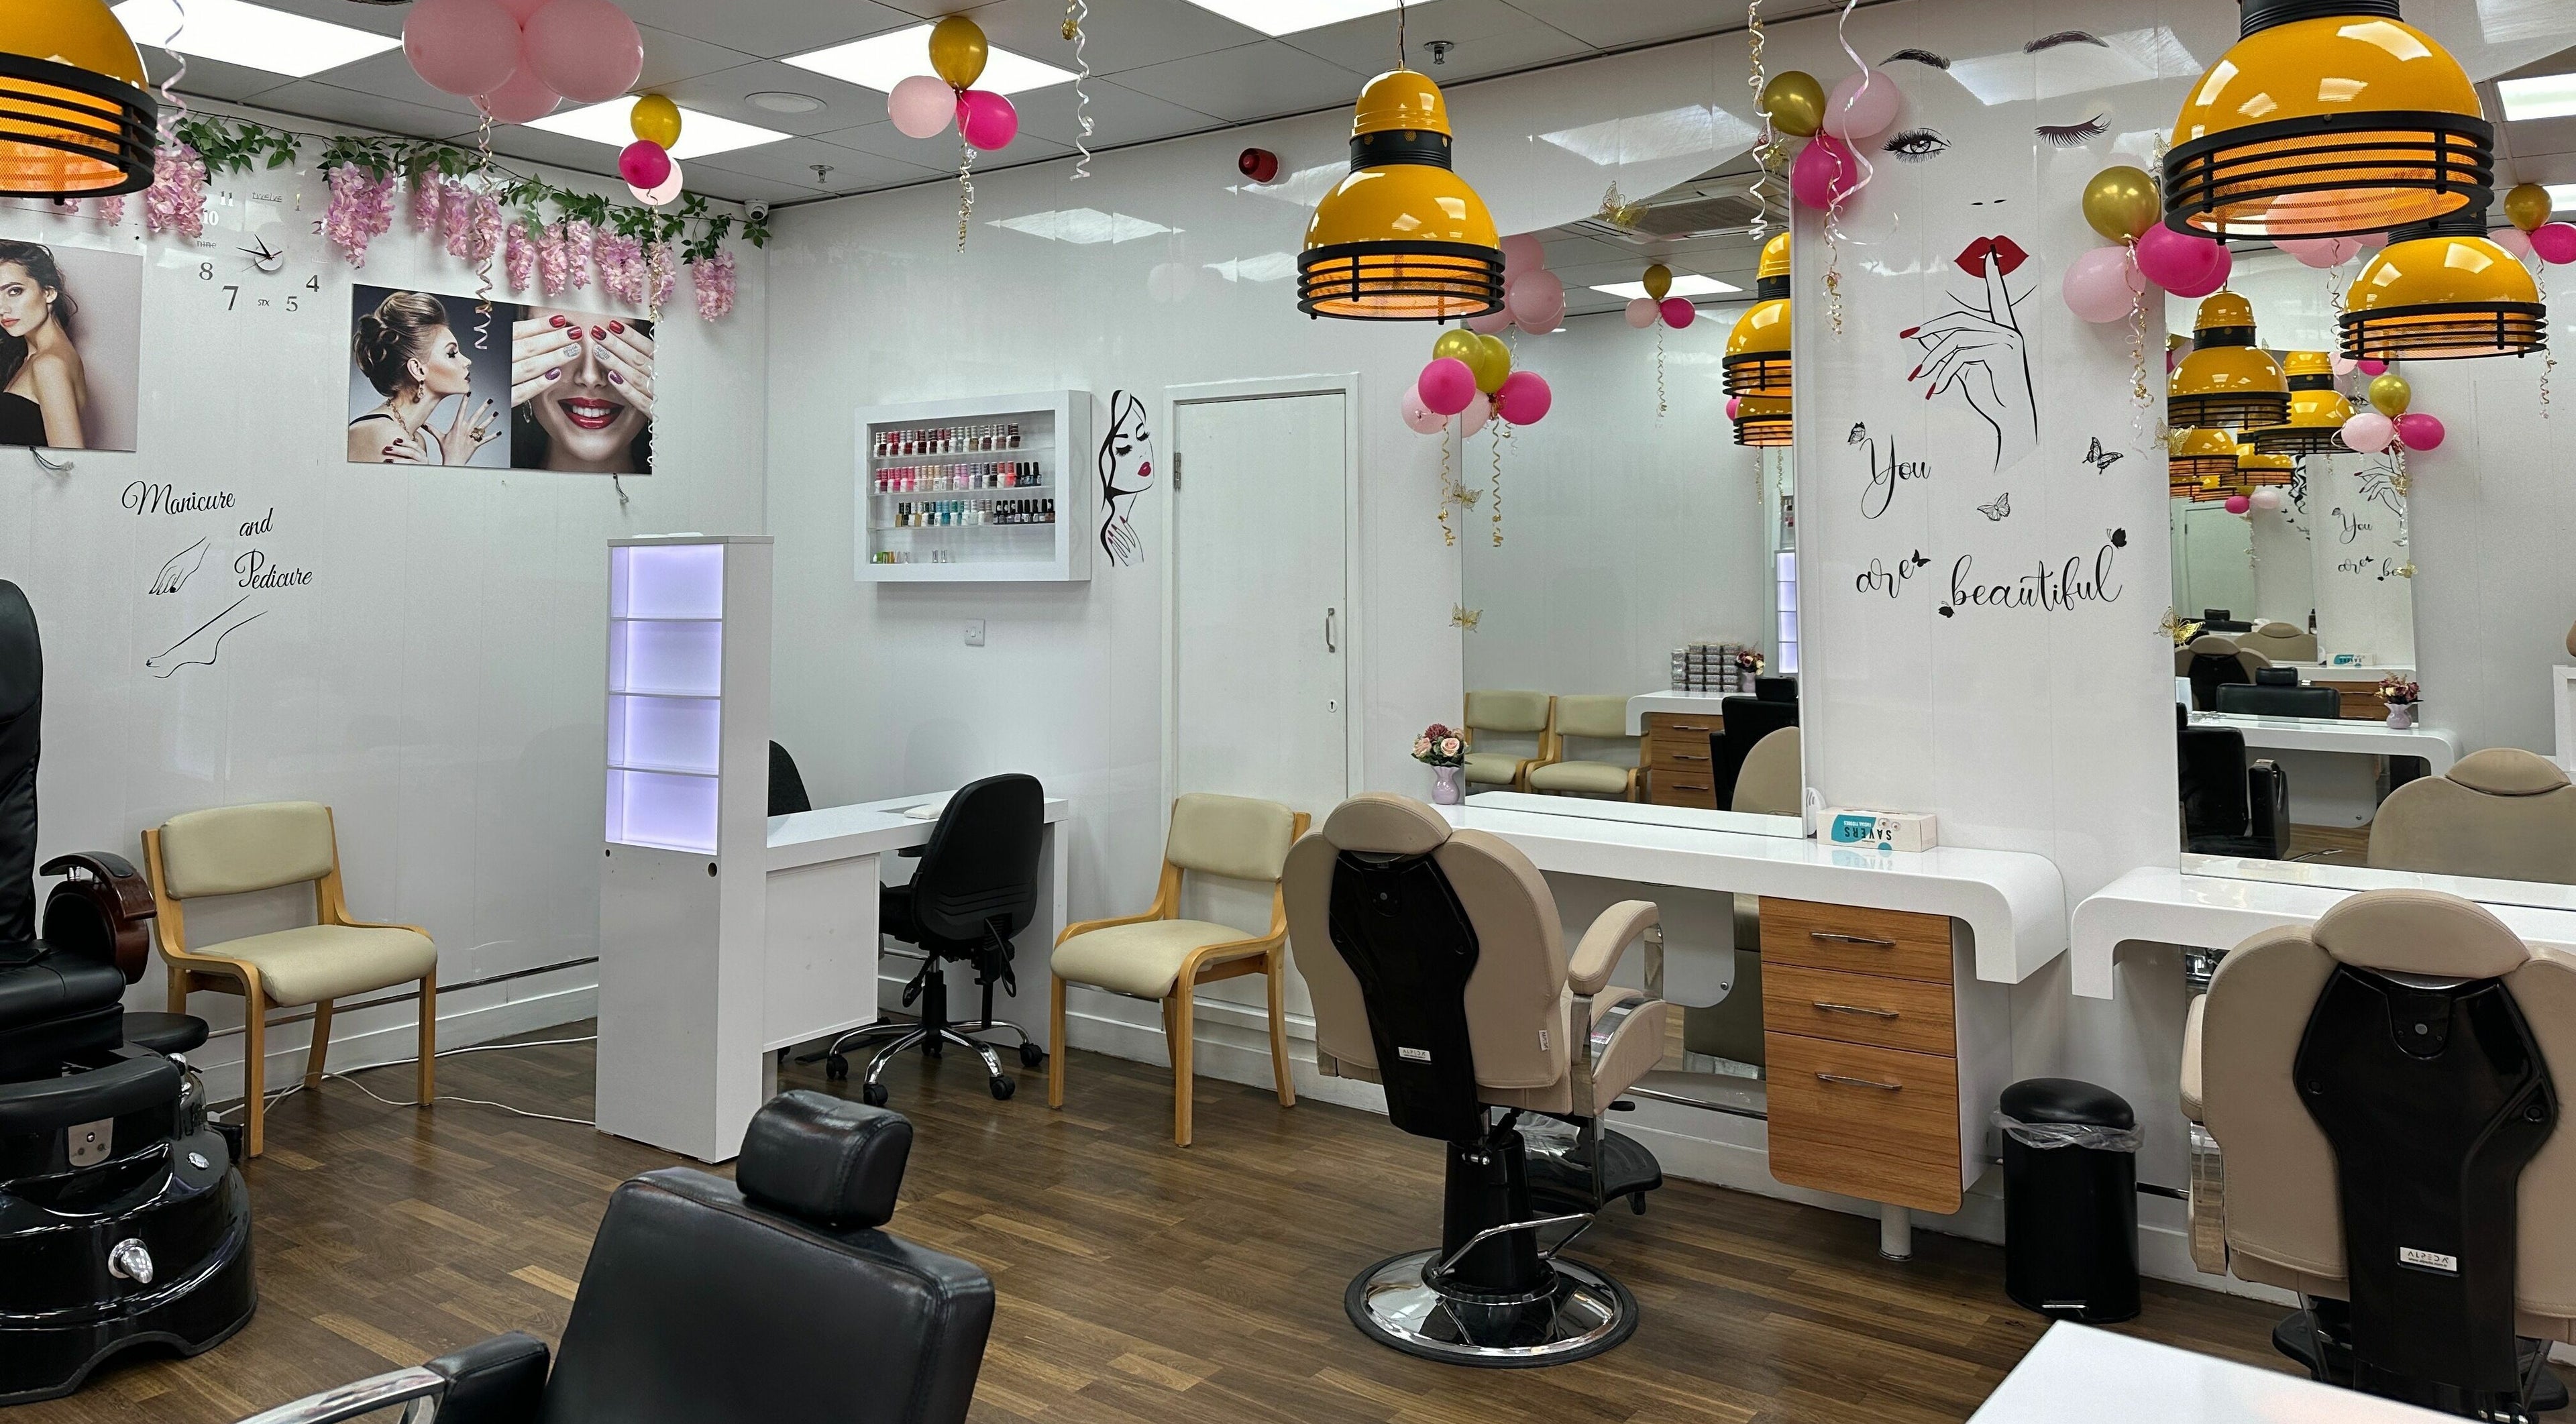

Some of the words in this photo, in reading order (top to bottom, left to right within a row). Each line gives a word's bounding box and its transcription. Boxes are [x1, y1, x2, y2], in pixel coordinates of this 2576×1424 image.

[220, 191, 233, 207] 11
[203, 210, 219, 226] 10
[197, 240, 217, 248] nine
[199, 262, 213, 280] 8
[306, 274, 319, 292] 4
[222, 285, 239, 311] 7
[286, 296, 298, 312] 5
[1860, 434, 1931, 519] You
[121, 480, 235, 515] Manicure
[239, 507, 274, 536] and
[2338, 512, 2373, 544] You
[234, 548, 313, 589] Pedicure
[2338, 559, 2367, 574] are
[1856, 558, 1915, 598] are
[1951, 544, 2123, 611] beautiful
[1844, 826, 1892, 840] SAVERS
